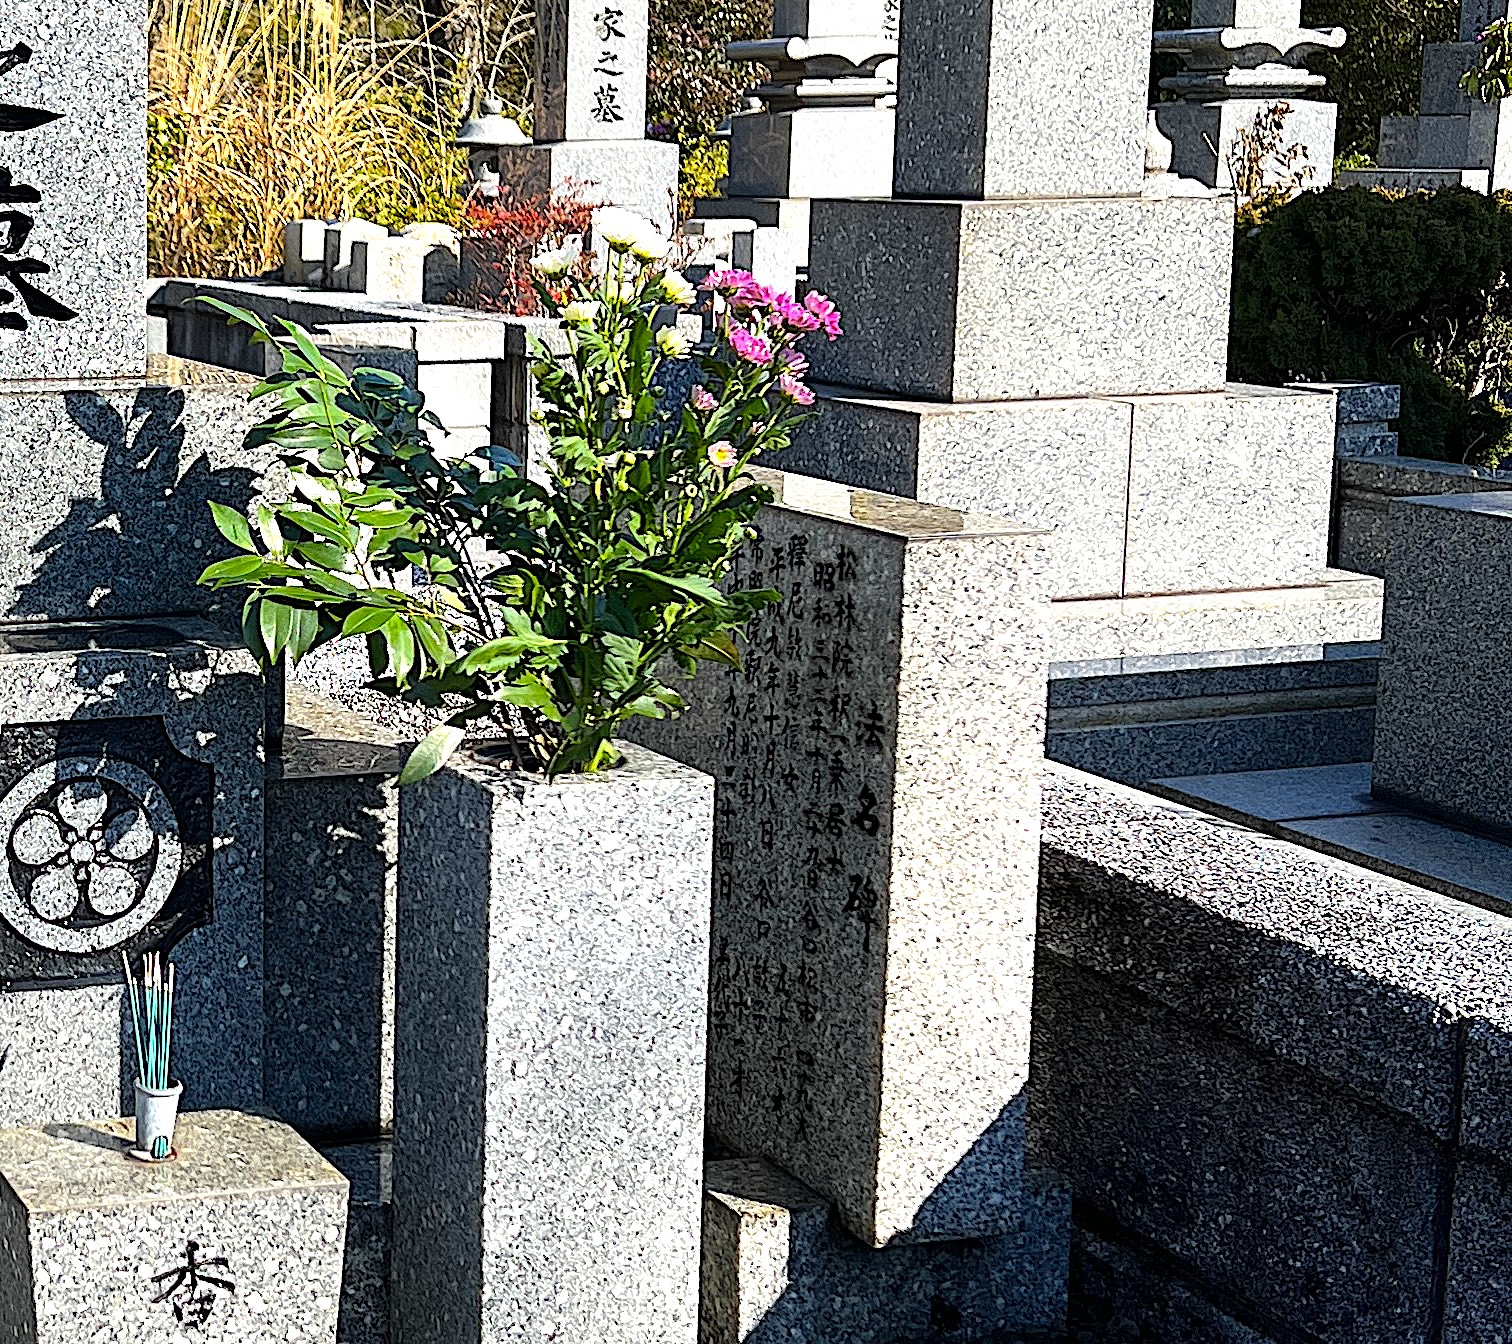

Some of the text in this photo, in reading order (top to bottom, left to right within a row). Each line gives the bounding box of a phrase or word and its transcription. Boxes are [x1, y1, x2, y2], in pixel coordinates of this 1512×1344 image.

[845, 694, 887, 954] 法名碑
[151, 1241, 236, 1333] 香
